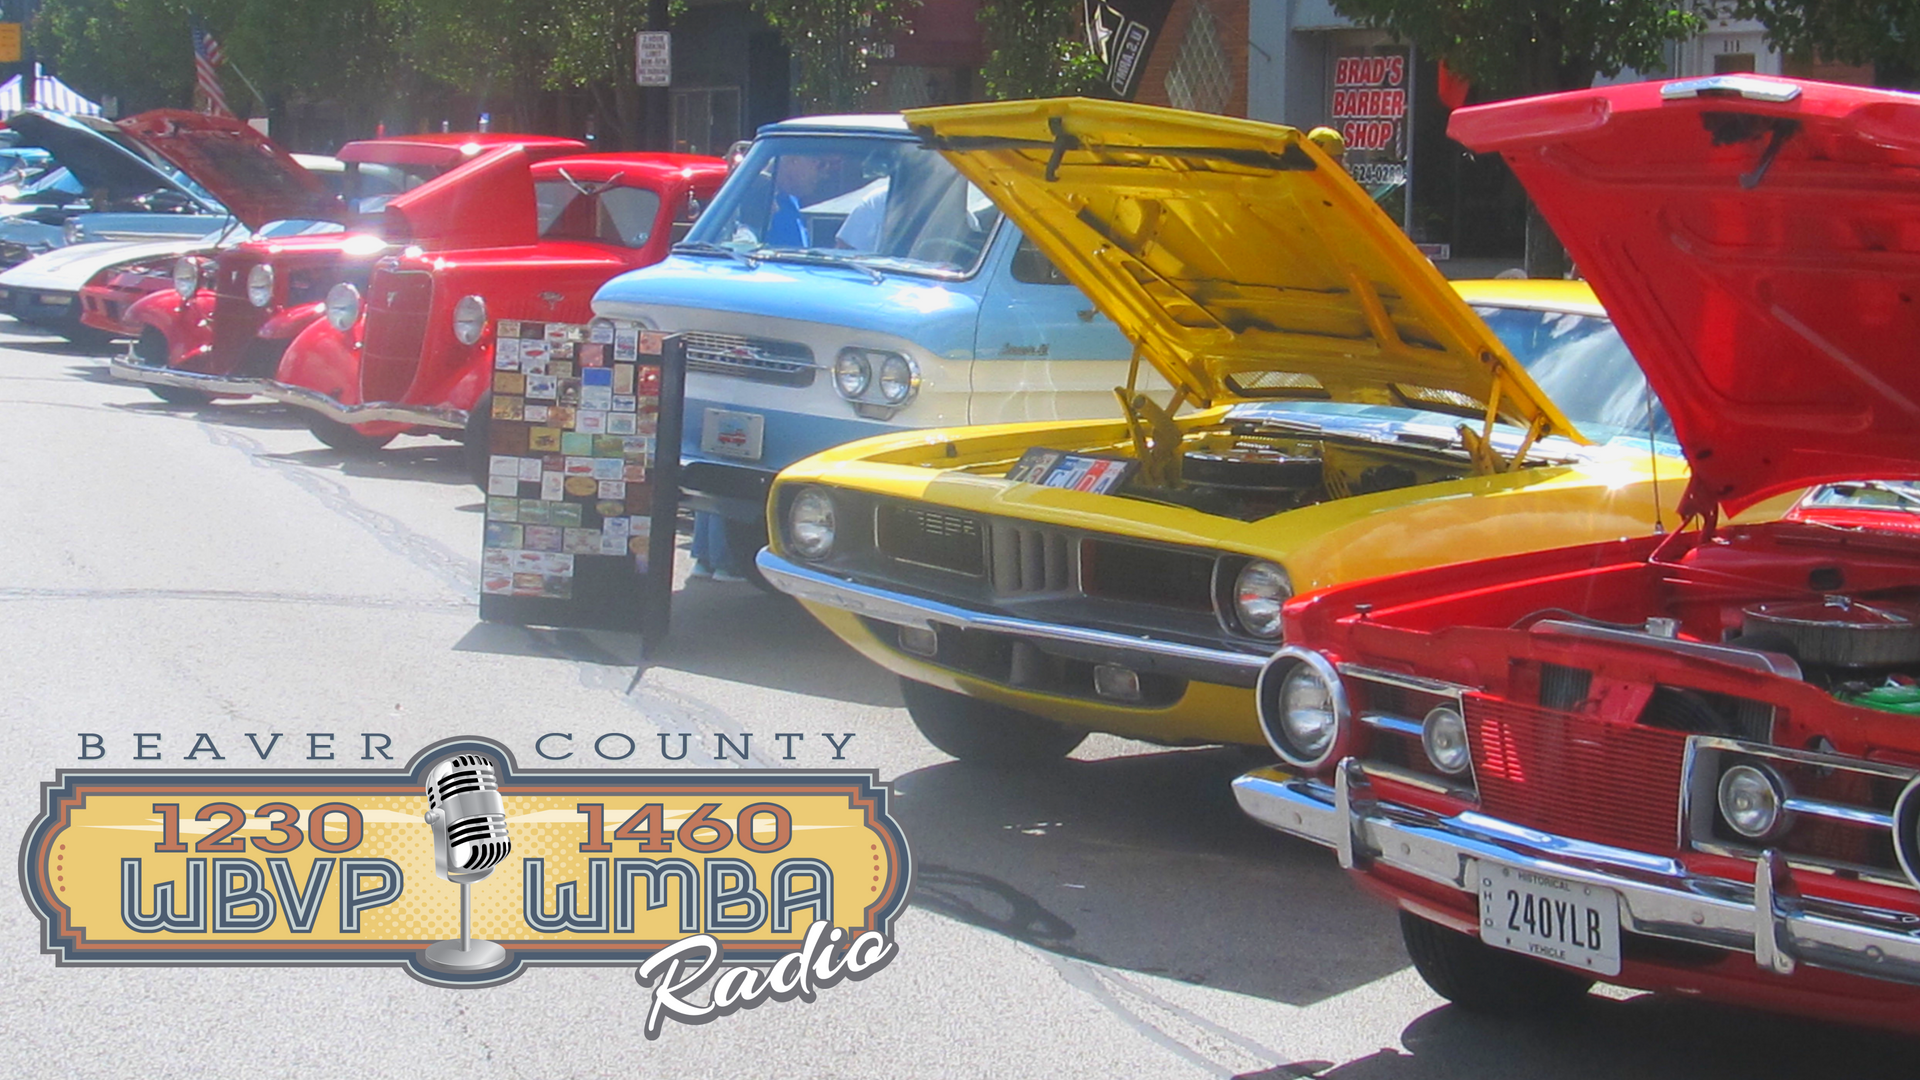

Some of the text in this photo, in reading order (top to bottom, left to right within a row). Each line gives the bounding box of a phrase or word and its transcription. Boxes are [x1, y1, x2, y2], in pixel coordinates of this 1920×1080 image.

[1335, 56, 1404, 86] BRAD'S
[1332, 88, 1405, 118] BARBER
[1343, 120, 1393, 150] SHOP
[1045, 469, 1112, 495] CUDA
[1518, 873, 1571, 892] HISTORICAL
[1483, 877, 1493, 927] OHIO
[1507, 889, 1602, 951] 240YLB
[1529, 942, 1566, 960] VEHICLE
